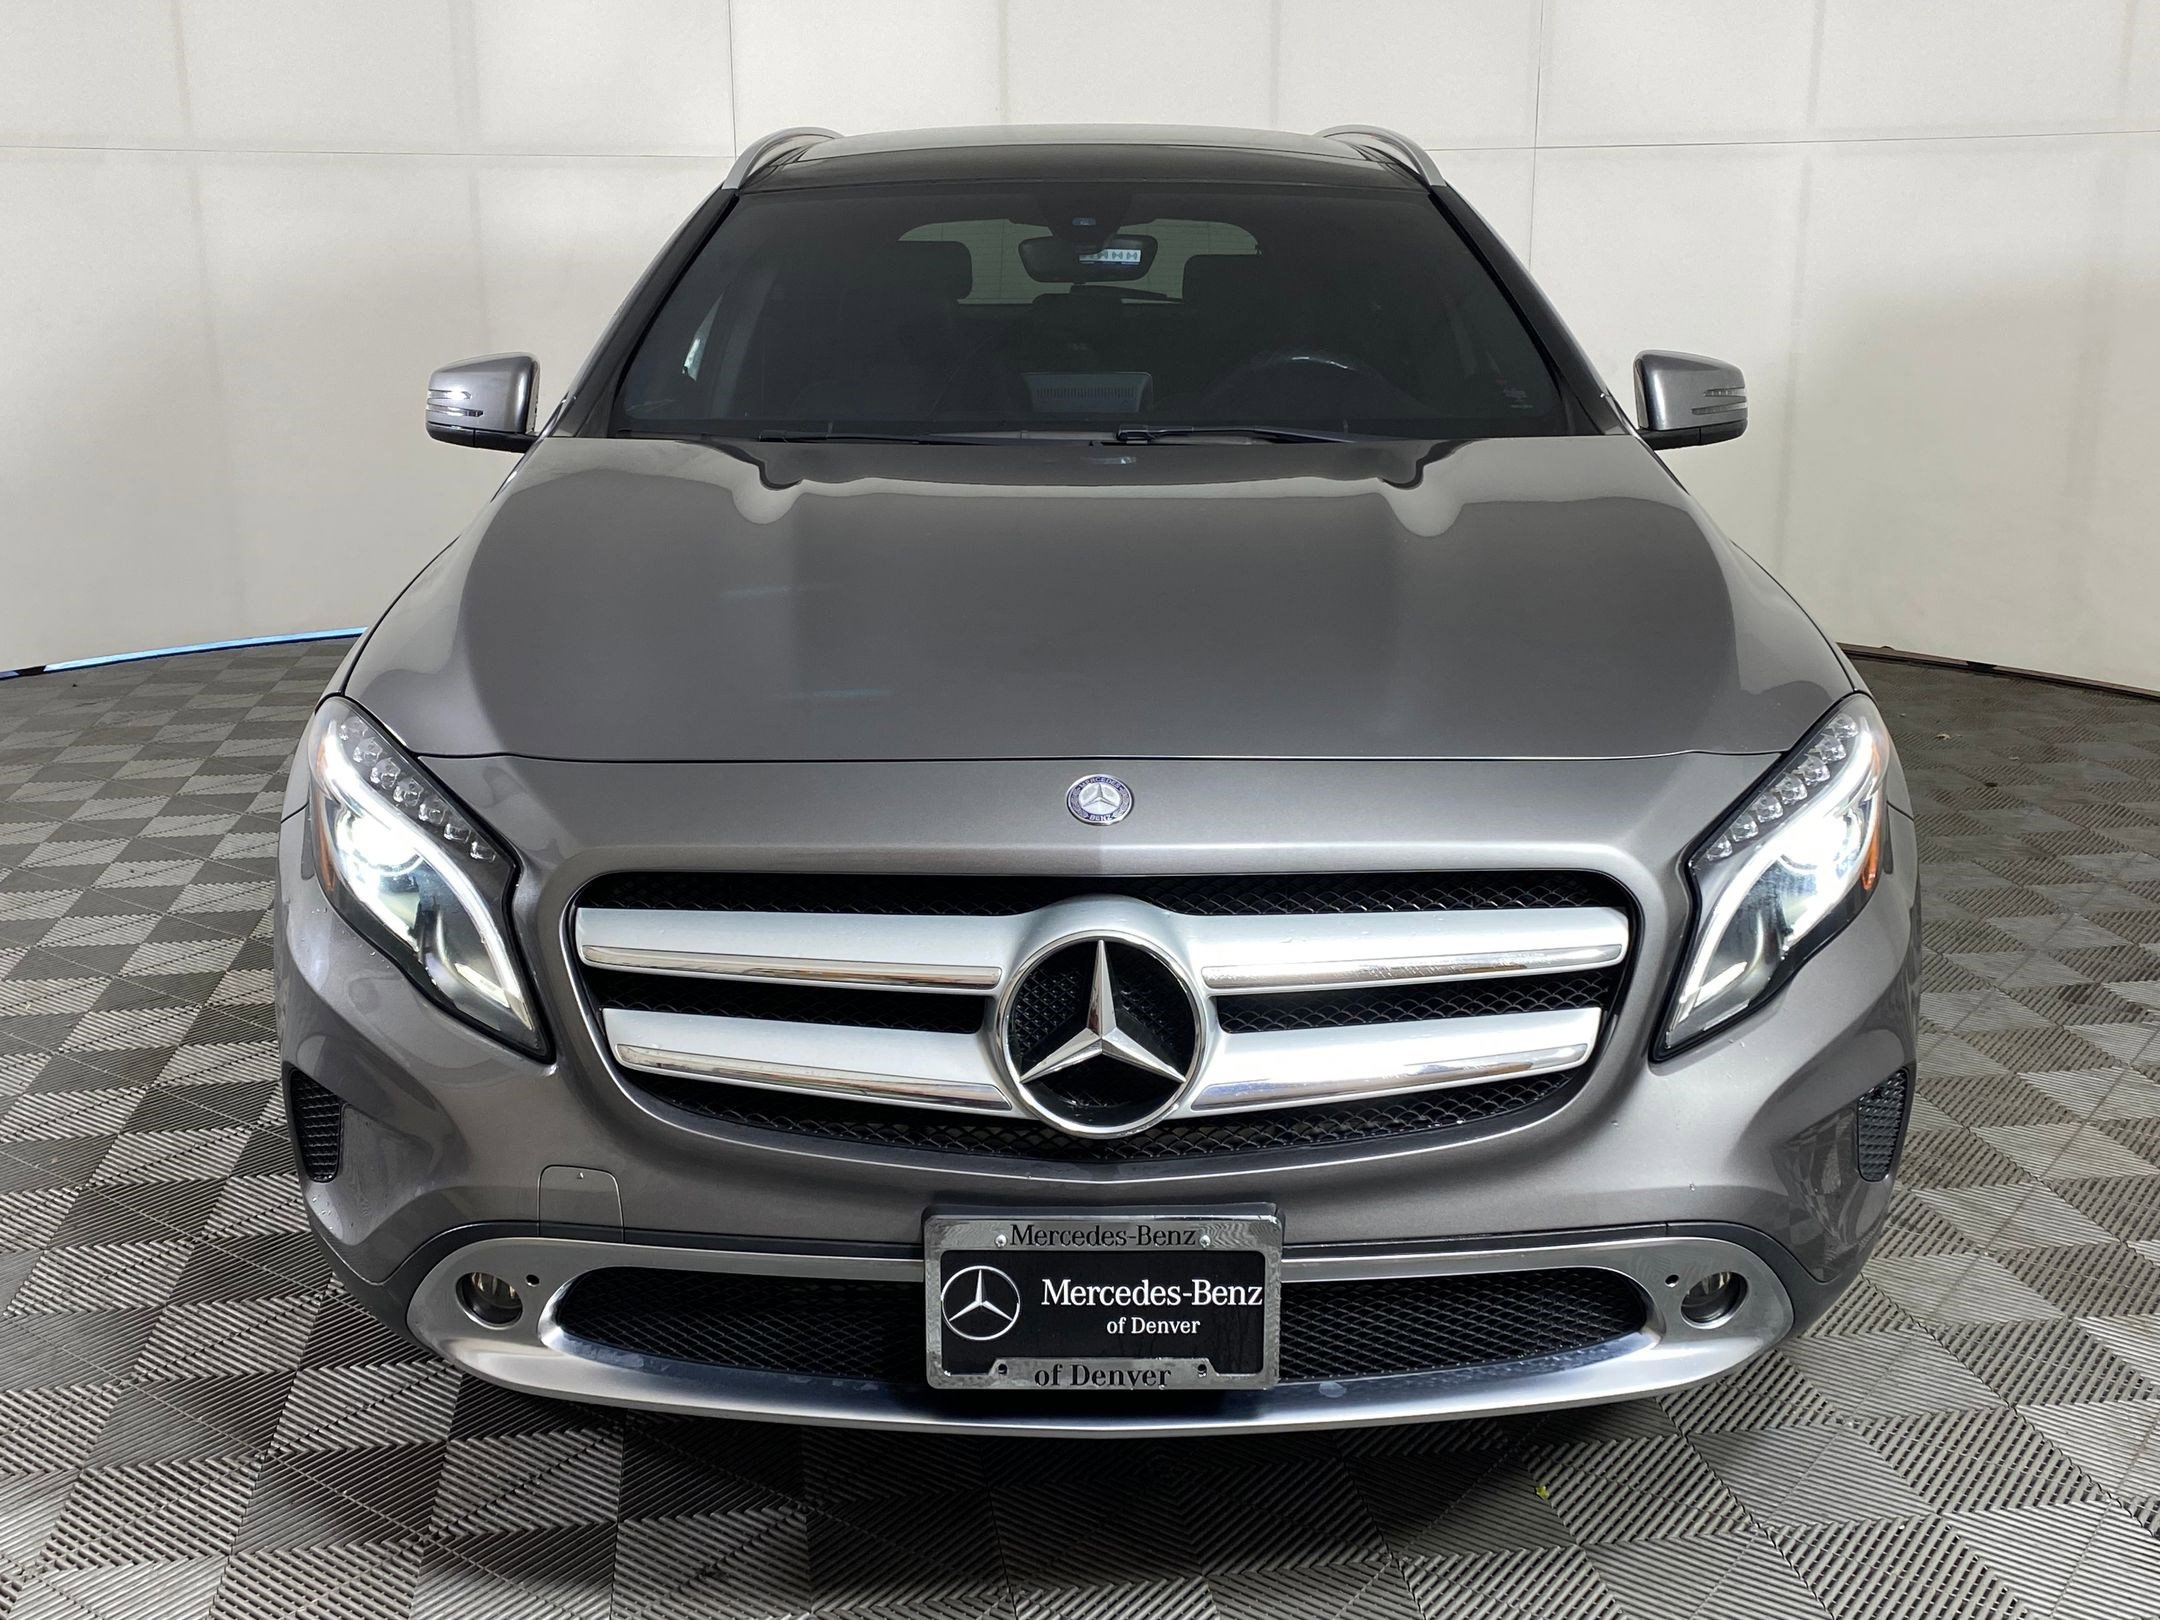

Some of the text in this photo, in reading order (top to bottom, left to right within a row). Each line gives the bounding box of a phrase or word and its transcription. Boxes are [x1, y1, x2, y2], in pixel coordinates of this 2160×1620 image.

[1010, 1224, 1196, 1247] Mercedes-Benz
[1041, 1279, 1263, 1306] Mercedes-Benz
[1106, 1317, 1200, 1334] of Denver
[1034, 1364, 1171, 1387] of Denver
